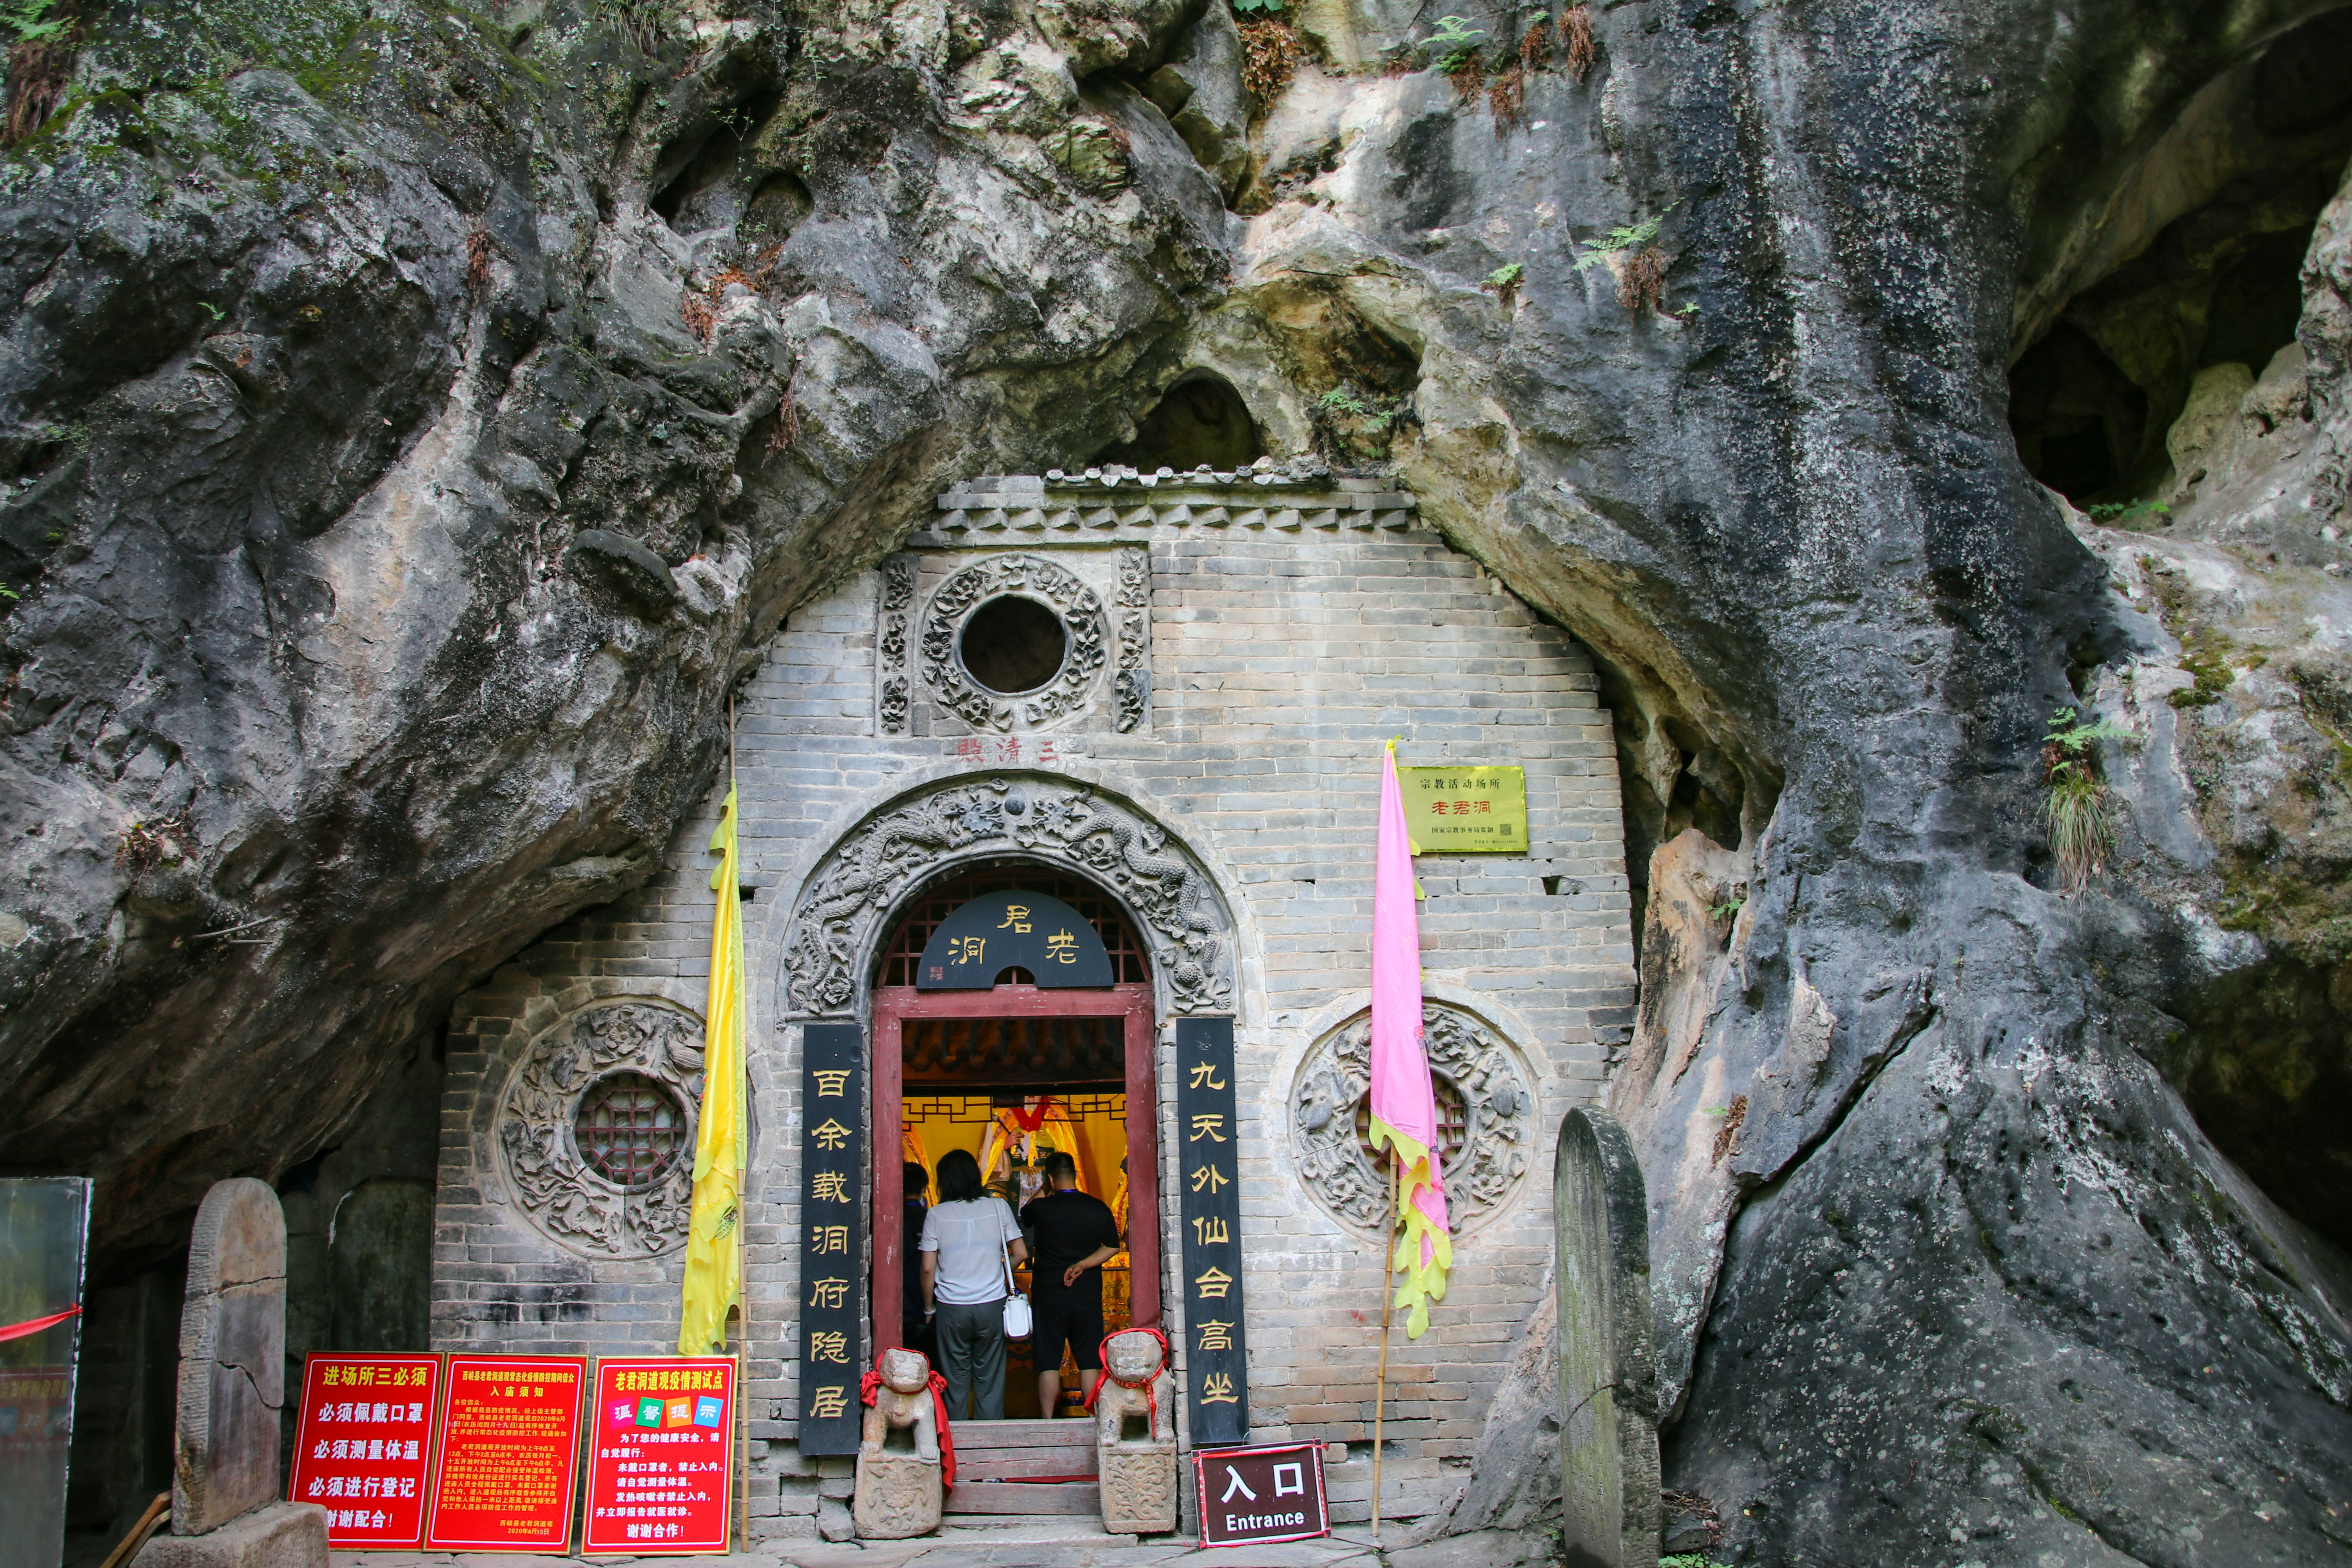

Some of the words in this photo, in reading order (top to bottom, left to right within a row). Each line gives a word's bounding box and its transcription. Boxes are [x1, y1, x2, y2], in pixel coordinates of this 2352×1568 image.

[1420, 778, 1501, 789] 宗教活动场所
[1432, 800, 1491, 815] 老君洞
[947, 904, 1080, 965] 老君洞
[809, 1069, 853, 1417] 百余载洞府隐居
[323, 1366, 427, 1386] 进场所三必须
[462, 1370, 574, 1383] 西峡县老君洞道观常态化疫情防控期间信众
[615, 1370, 723, 1391] 老君洞道观疫情测试点
[490, 1386, 544, 1397] 入庙须知
[318, 1402, 423, 1423] 必须佩戴口罩
[614, 1404, 717, 1421] 温馨提示
[314, 1439, 419, 1460] 必须测量体温
[308, 1476, 416, 1497] 必须进行登记
[616, 1476, 692, 1488] 请自觉测量体温。
[1220, 1462, 1304, 1504] 入口
[595, 1506, 692, 1517] 并立即报告就医就诊。
[1226, 1512, 1305, 1532] Entrance
